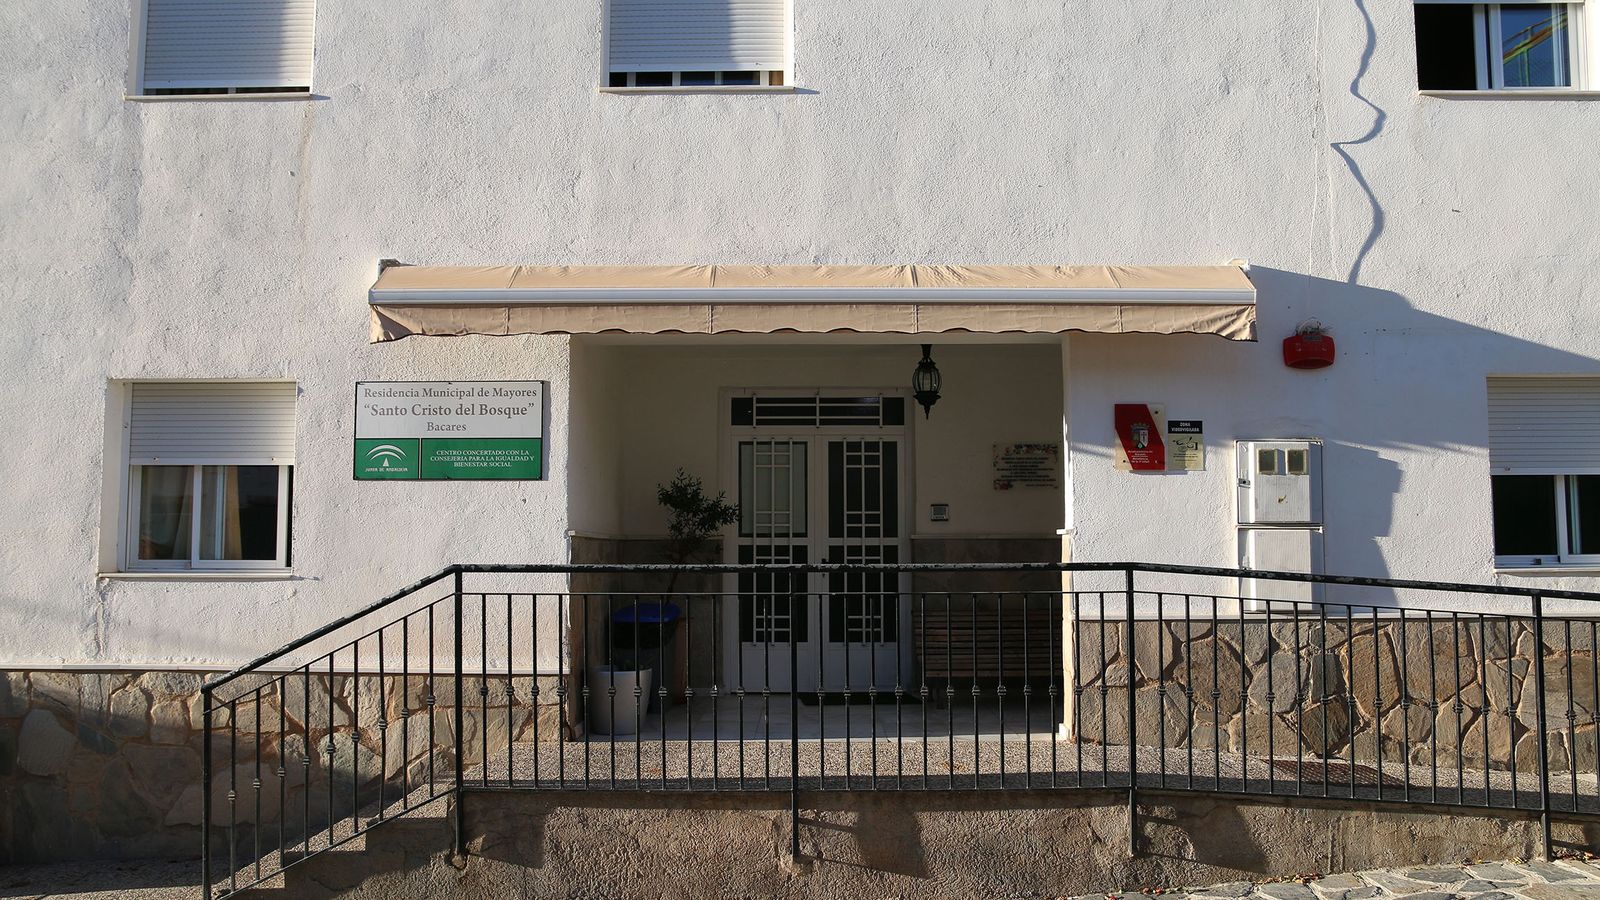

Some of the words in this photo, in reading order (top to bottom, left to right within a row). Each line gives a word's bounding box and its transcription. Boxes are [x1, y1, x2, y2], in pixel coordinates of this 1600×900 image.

[364, 388, 419, 398] Residencia
[422, 388, 474, 400] Municipal
[477, 388, 490, 397] de
[492, 388, 537, 400] Mayores
[412, 404, 452, 416] Cristo
[455, 404, 476, 416] del
[427, 422, 466, 432] Bacares
